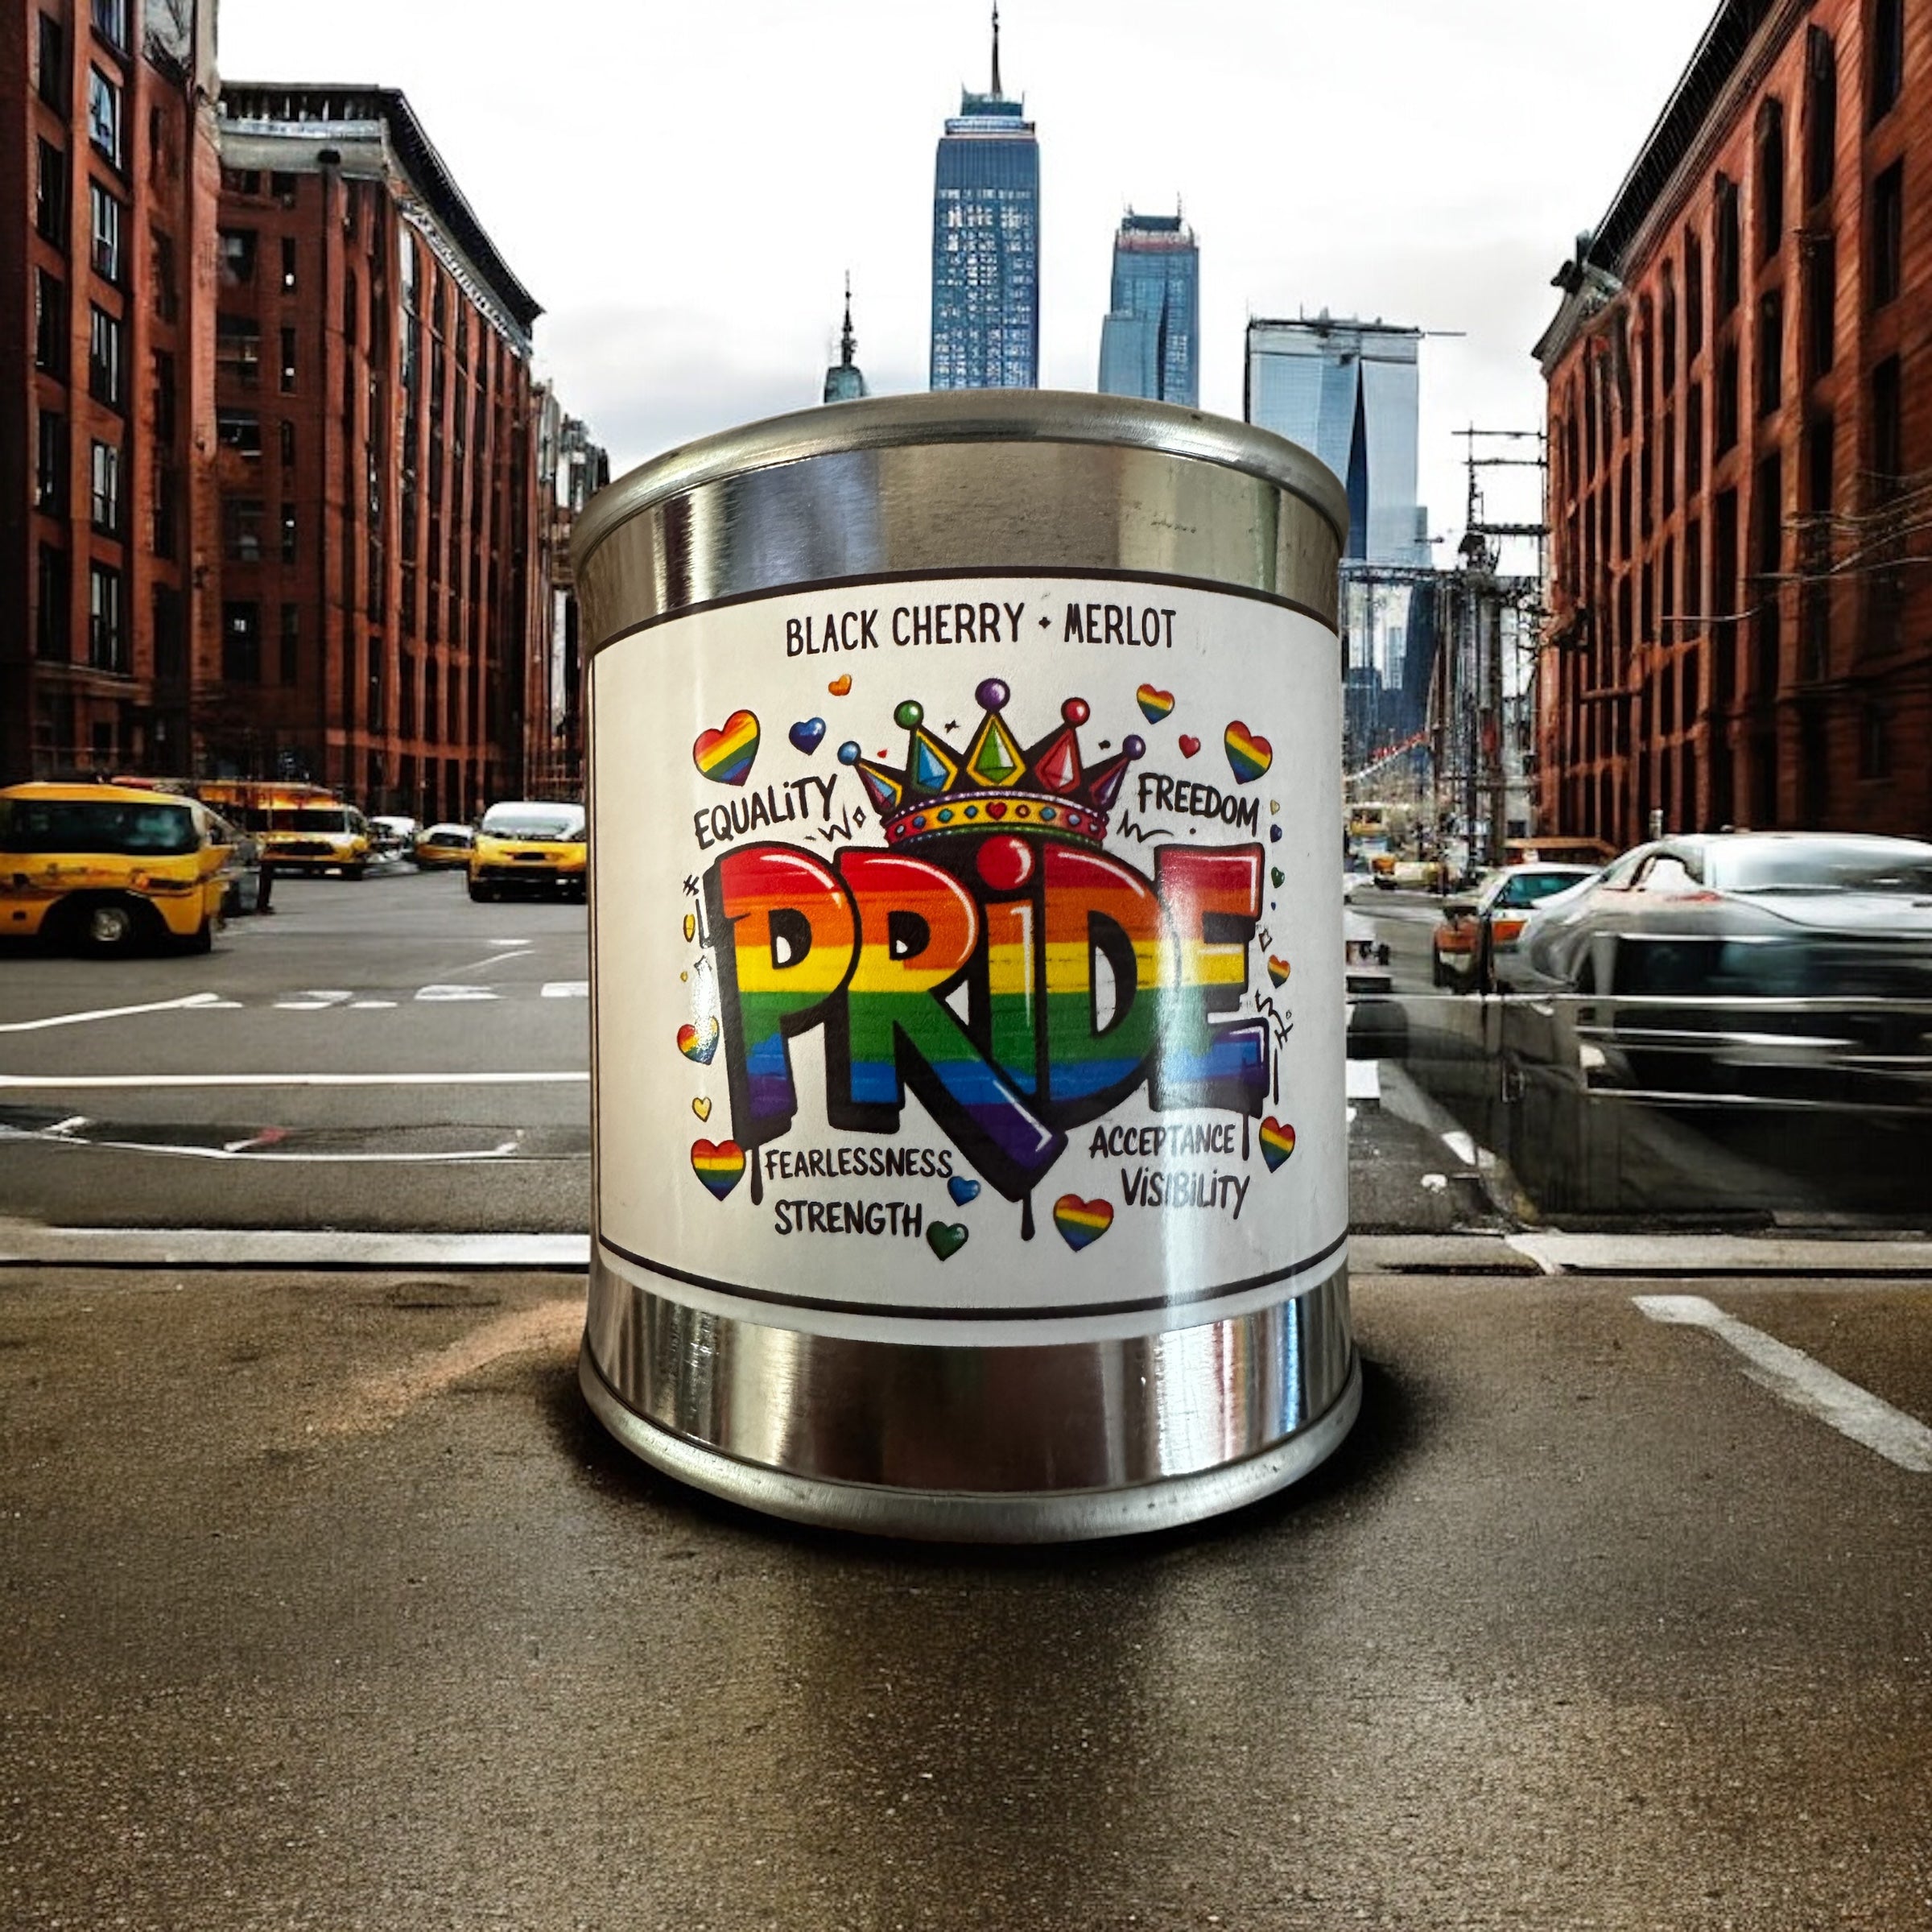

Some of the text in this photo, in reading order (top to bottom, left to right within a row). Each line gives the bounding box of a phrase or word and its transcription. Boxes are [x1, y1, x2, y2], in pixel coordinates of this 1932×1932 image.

[786, 602, 1177, 657] BLACK CHERRY MERLOT
[1138, 772, 1260, 837] FREEDOM
[1089, 1124, 1235, 1159] ACCEPTANCE
[765, 1147, 953, 1179] FEARLESSNESS
[774, 1199, 923, 1237] STRENGTH
